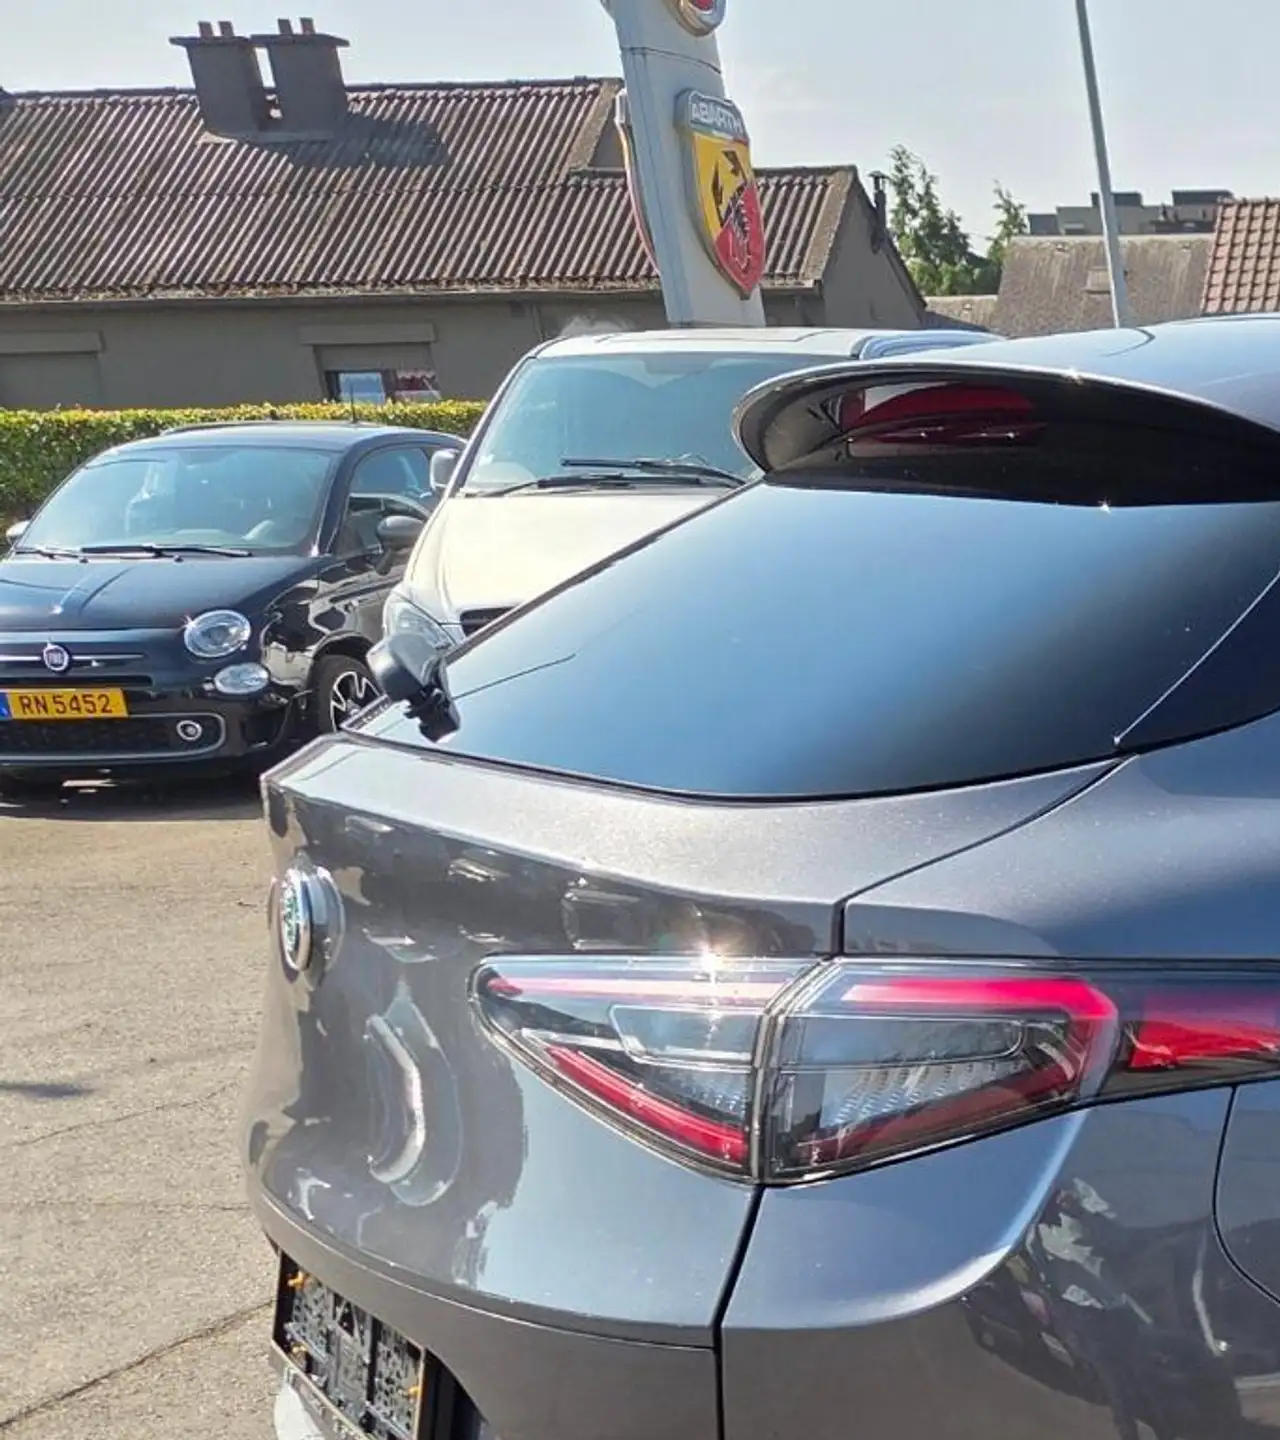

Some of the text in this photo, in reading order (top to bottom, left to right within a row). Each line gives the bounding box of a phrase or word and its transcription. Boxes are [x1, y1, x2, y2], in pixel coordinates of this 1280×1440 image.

[691, 101, 743, 135] ABARTH
[18, 694, 113, 715] RN 5452
